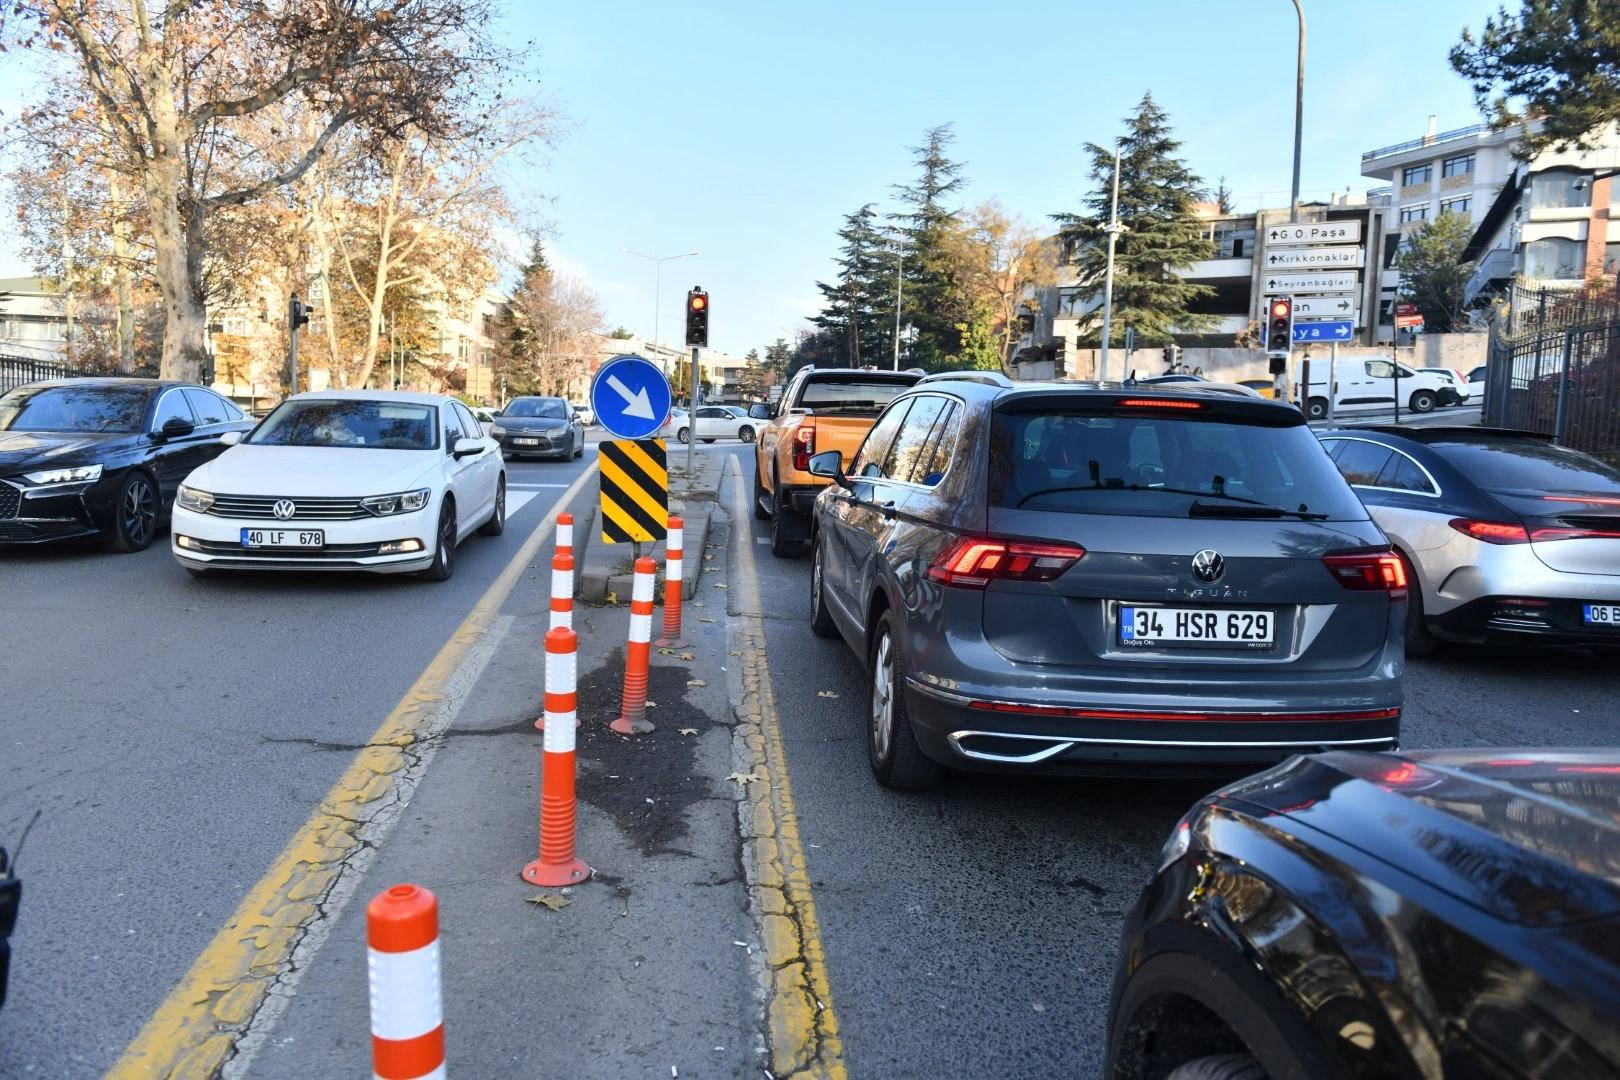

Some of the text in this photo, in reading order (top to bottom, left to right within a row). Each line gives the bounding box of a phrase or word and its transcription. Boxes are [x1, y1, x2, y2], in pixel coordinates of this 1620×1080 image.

[1278, 253, 1355, 262] Kırkkonaklar
[1277, 280, 1353, 288] Seyranbağları
[249, 532, 321, 545] 40 LF 678
[1592, 607, 1608, 621] 06
[1123, 625, 1133, 634] TR
[1136, 611, 1268, 640] 34 HSR 629
